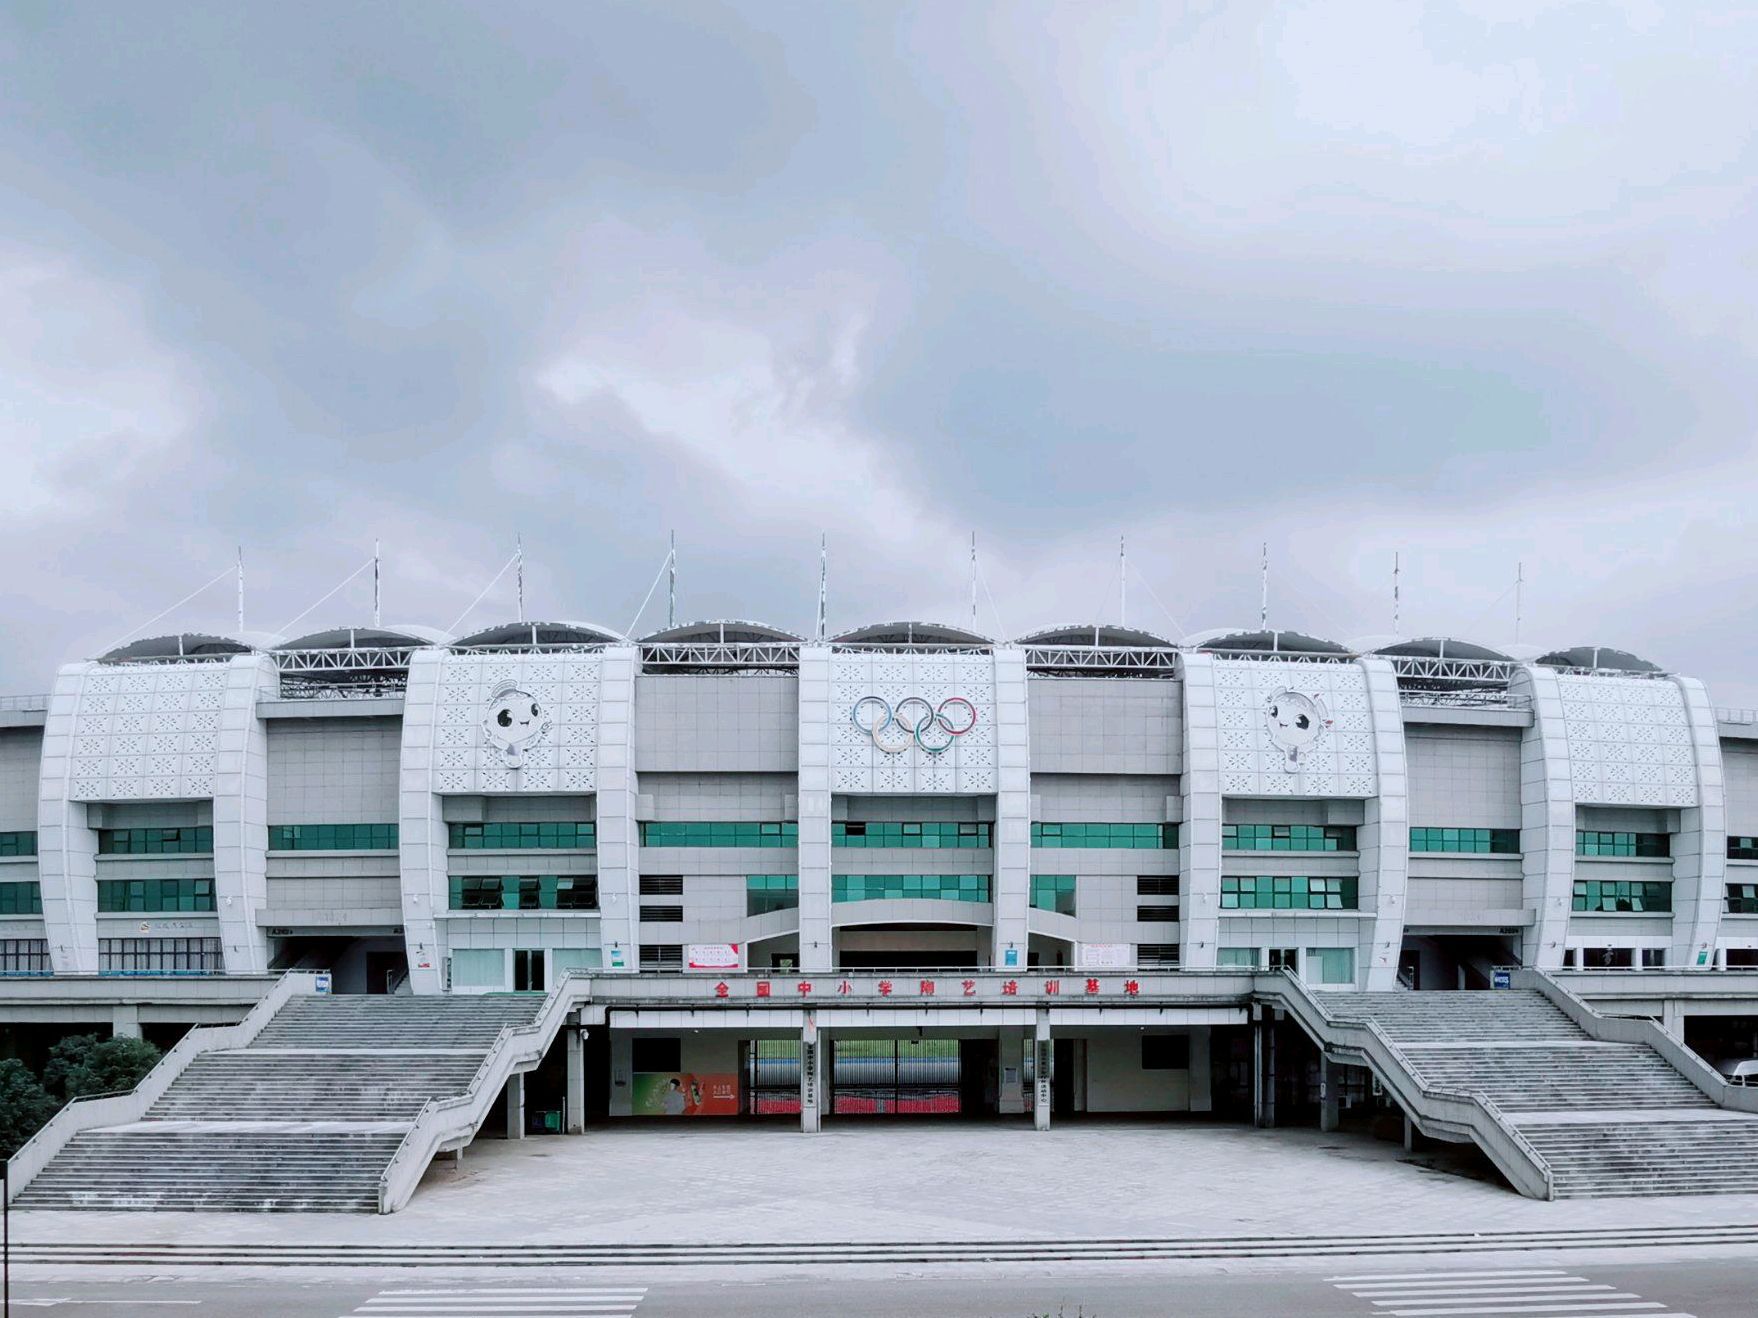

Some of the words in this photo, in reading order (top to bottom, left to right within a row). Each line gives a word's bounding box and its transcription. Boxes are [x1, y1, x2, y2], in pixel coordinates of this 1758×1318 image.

[714, 979, 1139, 998] 全国中小学陶艺培训基地
